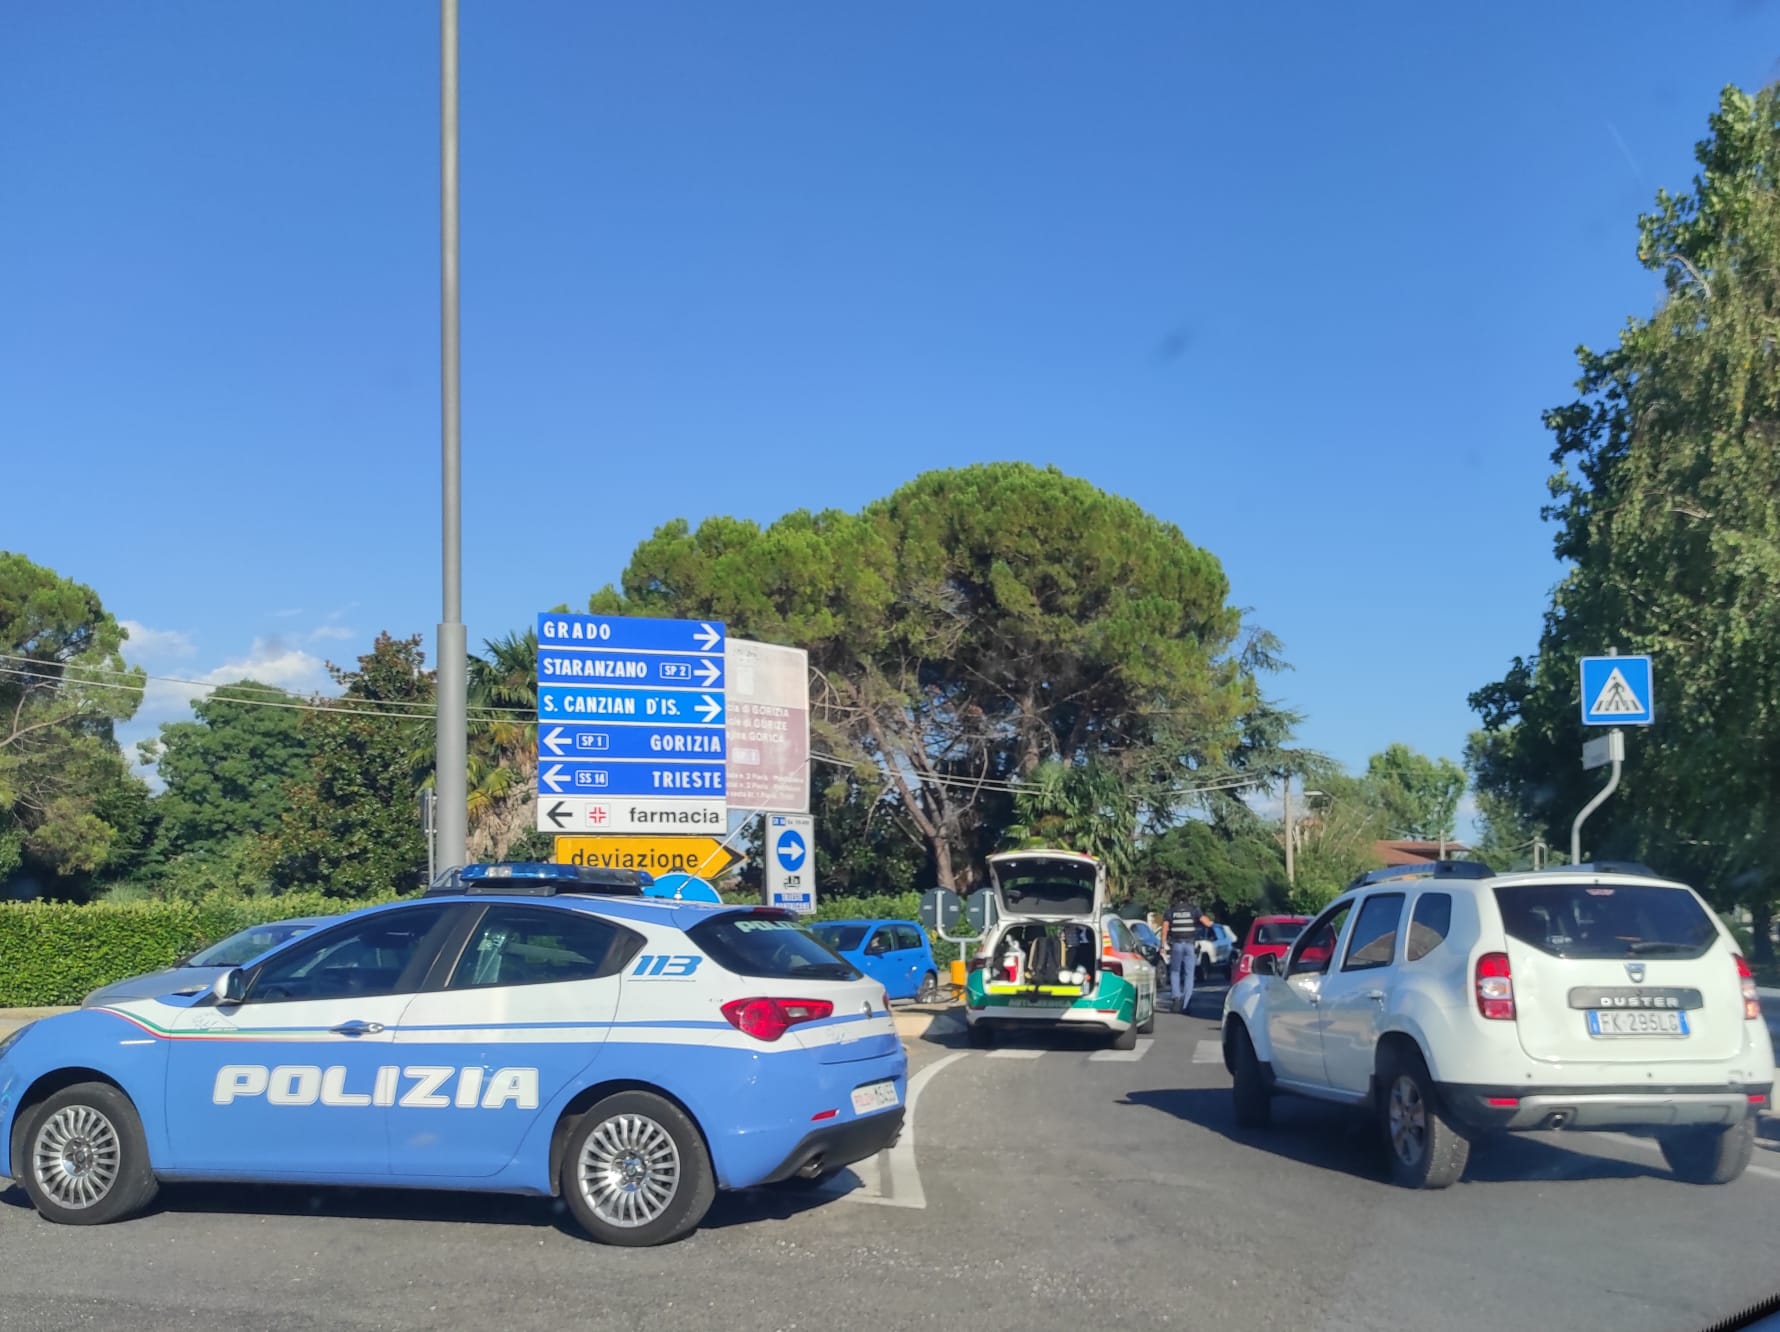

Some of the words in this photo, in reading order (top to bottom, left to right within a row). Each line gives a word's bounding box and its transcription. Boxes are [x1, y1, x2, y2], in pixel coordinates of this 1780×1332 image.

[543, 621, 611, 640] GRADO
[543, 658, 648, 678] STARANZANO
[664, 665, 677, 676] SP
[679, 666, 686, 676] 2
[543, 695, 558, 712] S.
[563, 695, 635, 714] CANZIAN
[581, 735, 594, 745] SP
[596, 735, 602, 746] 1
[650, 735, 721, 753] GORIZIA
[578, 772, 592, 783] SS
[594, 773, 605, 784] 14
[652, 771, 722, 788] TRIESTE
[630, 807, 719, 824] farmacia
[571, 848, 698, 868] deviazione
[632, 955, 703, 976] 113
[1600, 997, 1679, 1008] DUSTER
[212, 1064, 539, 1109] POLIZIA
